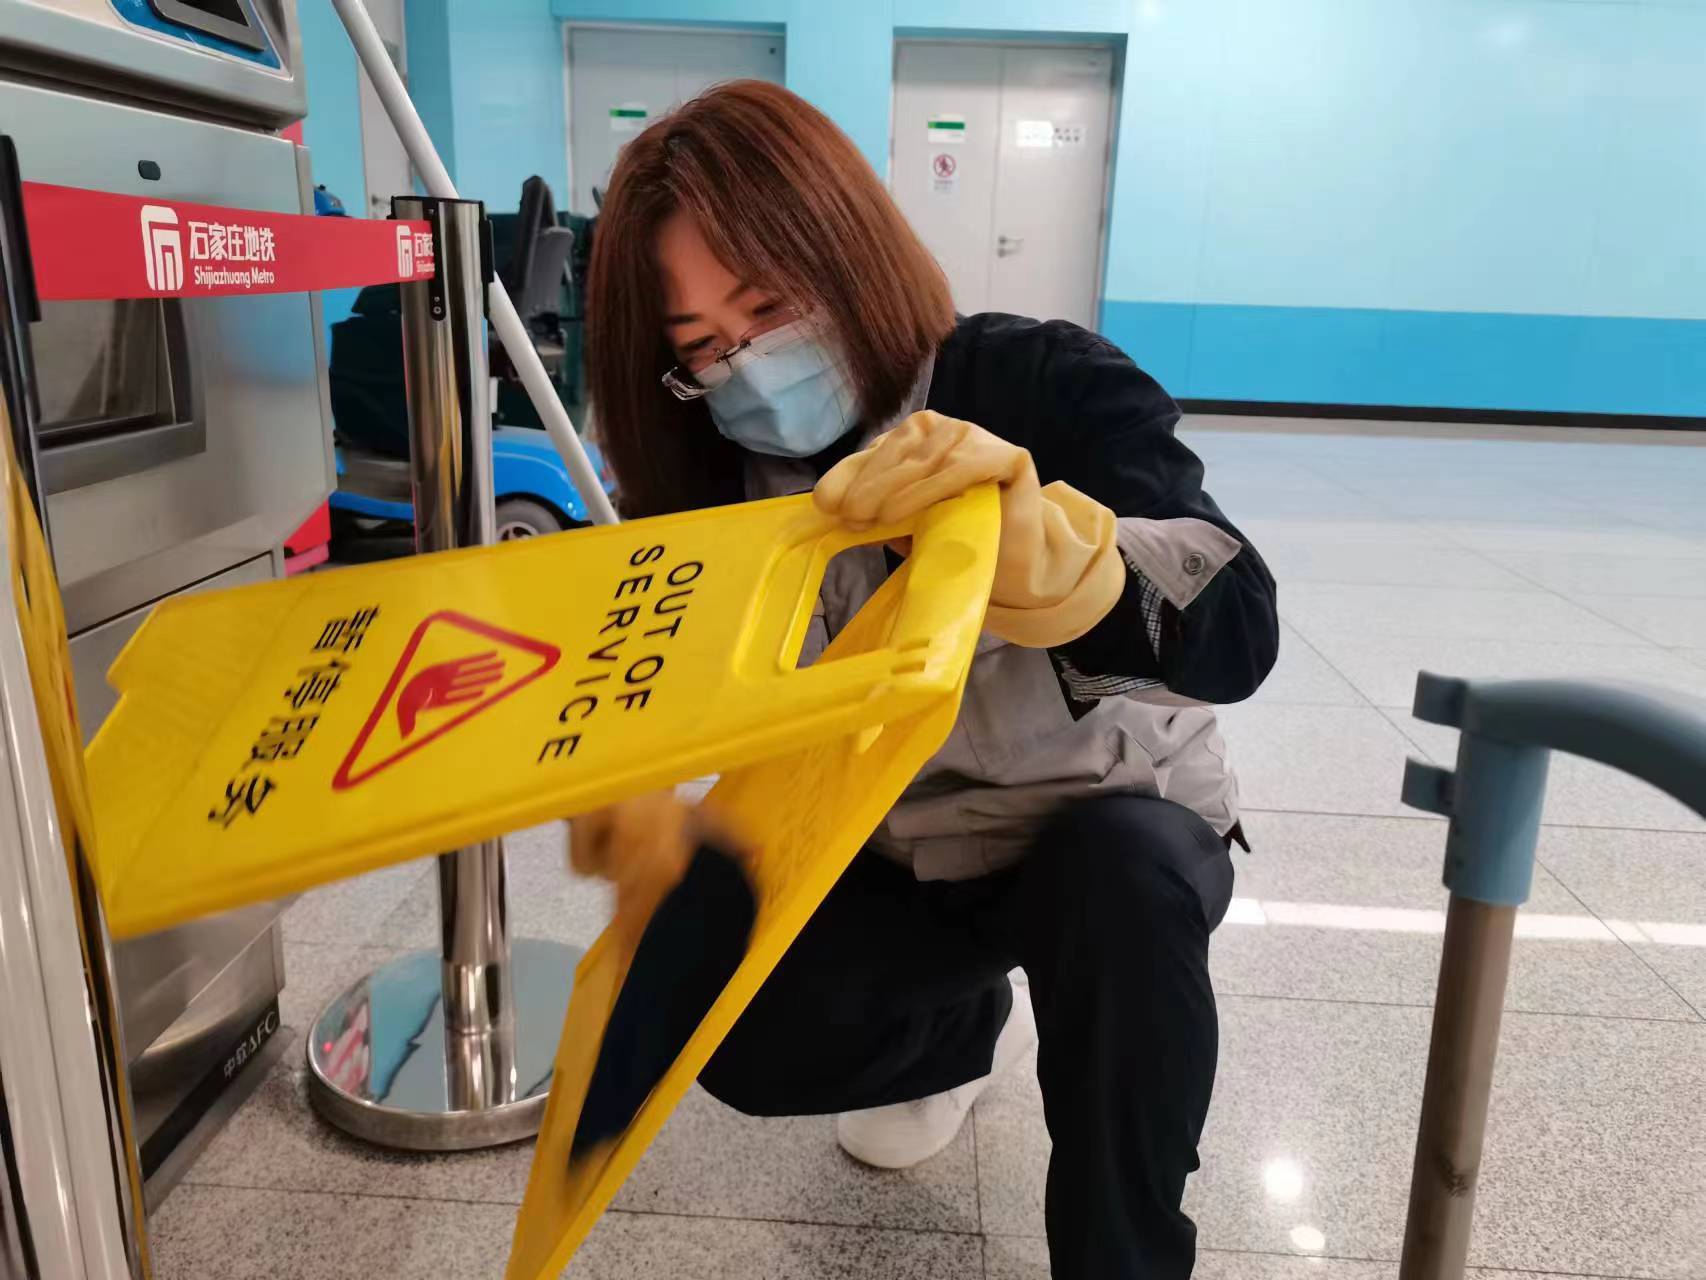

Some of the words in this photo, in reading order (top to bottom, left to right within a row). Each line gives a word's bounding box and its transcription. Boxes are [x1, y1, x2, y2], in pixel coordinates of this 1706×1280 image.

[188, 221, 275, 261] 石家庄地铁
[194, 266, 250, 289] Shijiazhuang
[251, 268, 276, 285] Metro
[644, 561, 704, 638] OUT
[538, 545, 665, 764] SERVICE
[614, 655, 664, 712] OF
